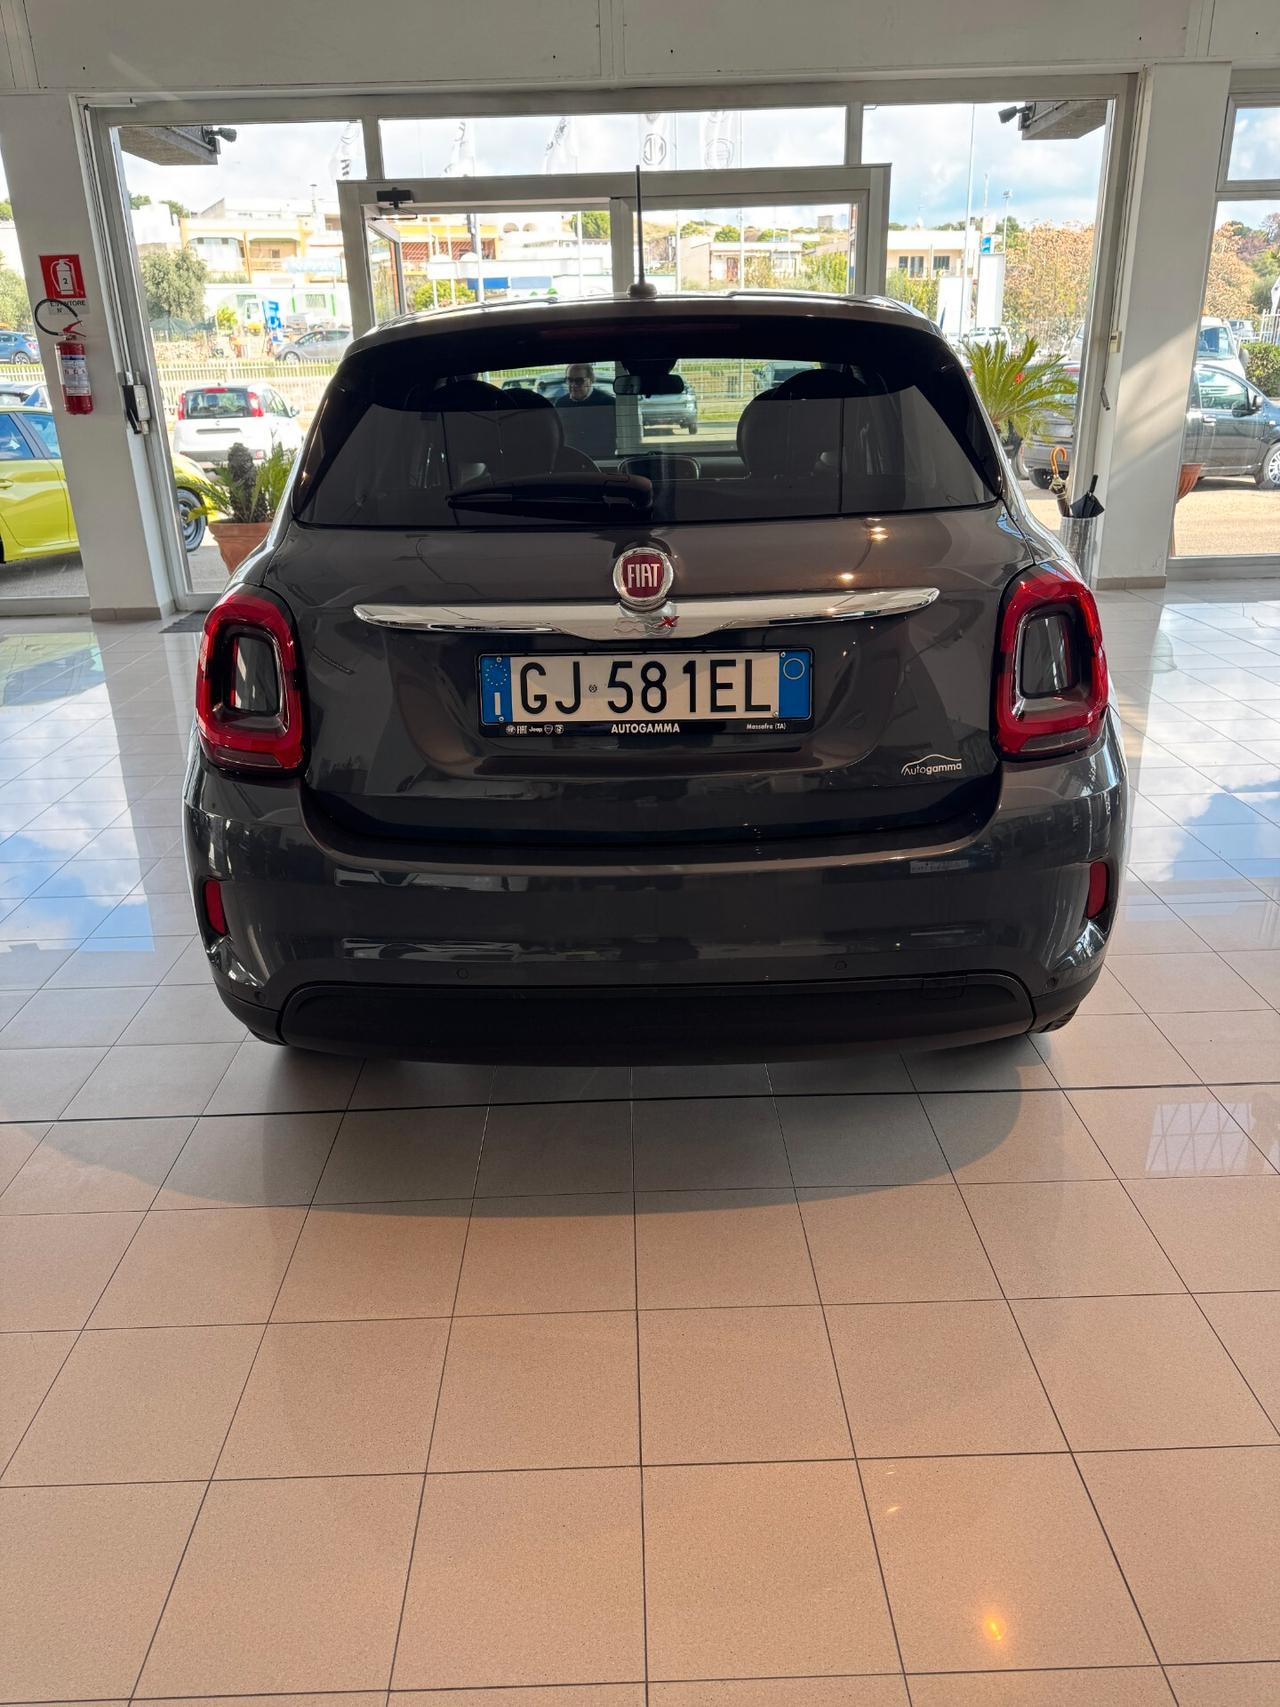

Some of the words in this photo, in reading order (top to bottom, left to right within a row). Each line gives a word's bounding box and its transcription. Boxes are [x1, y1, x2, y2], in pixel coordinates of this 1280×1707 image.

[627, 563, 660, 588] FIAT
[520, 660, 581, 715] GJ
[494, 692, 501, 716] I
[611, 723, 680, 734] AUTOGAMMA
[903, 762, 962, 776] Autogamma
